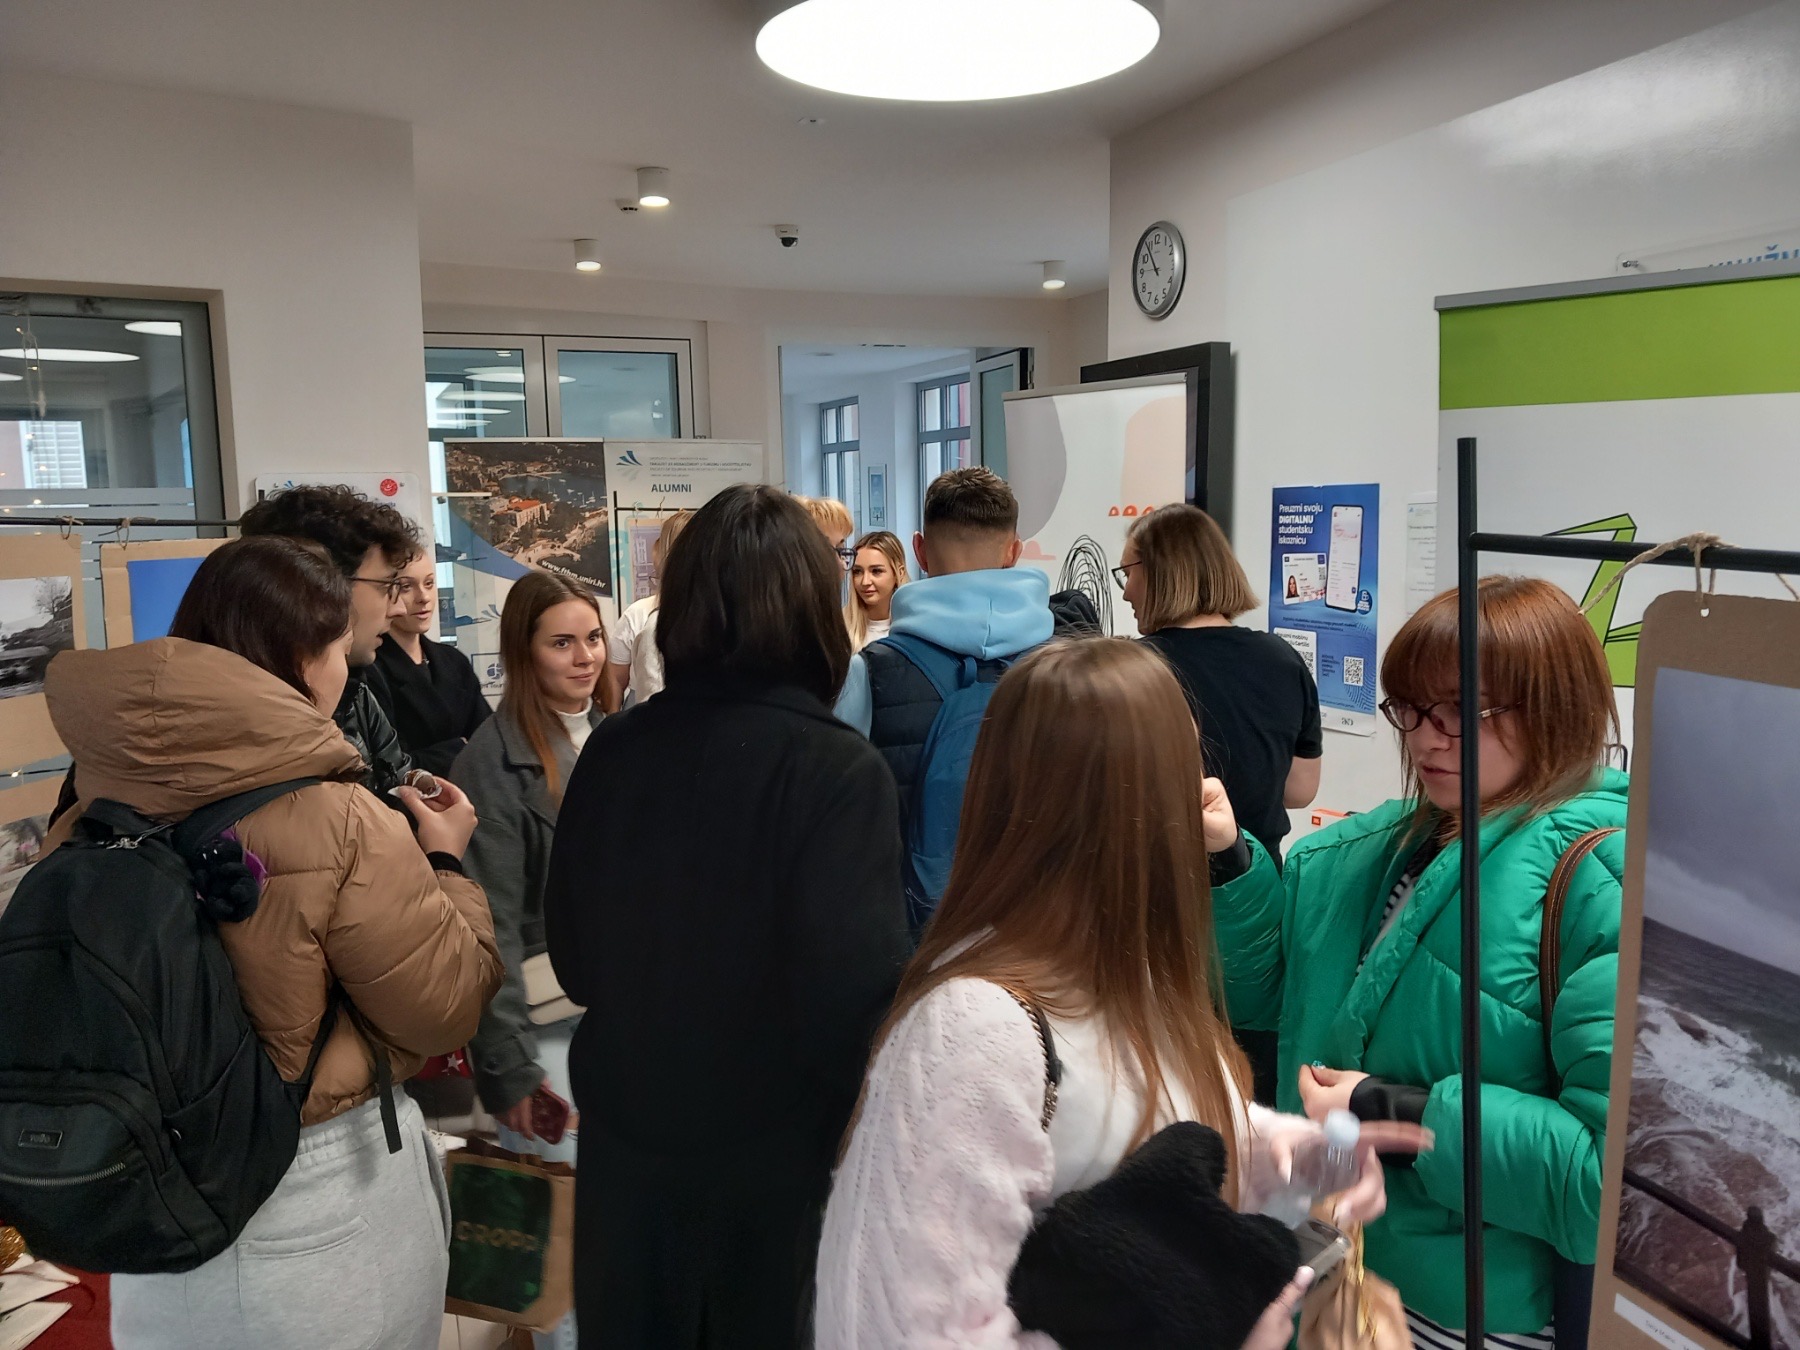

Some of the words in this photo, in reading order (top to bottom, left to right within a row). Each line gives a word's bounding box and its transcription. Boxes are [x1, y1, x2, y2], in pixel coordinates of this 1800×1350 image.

[1142, 254, 1149, 264] 10
[651, 484, 692, 493] ALUMNI
[1279, 503, 1303, 513] Preuzmi
[1304, 503, 1323, 515] svoju
[1279, 514, 1314, 524] DIGITALNU
[1279, 525, 1313, 534] studentsku
[1278, 535, 1307, 545] iskaznicu
[541, 560, 606, 588] www.fthm.uniri.hr
